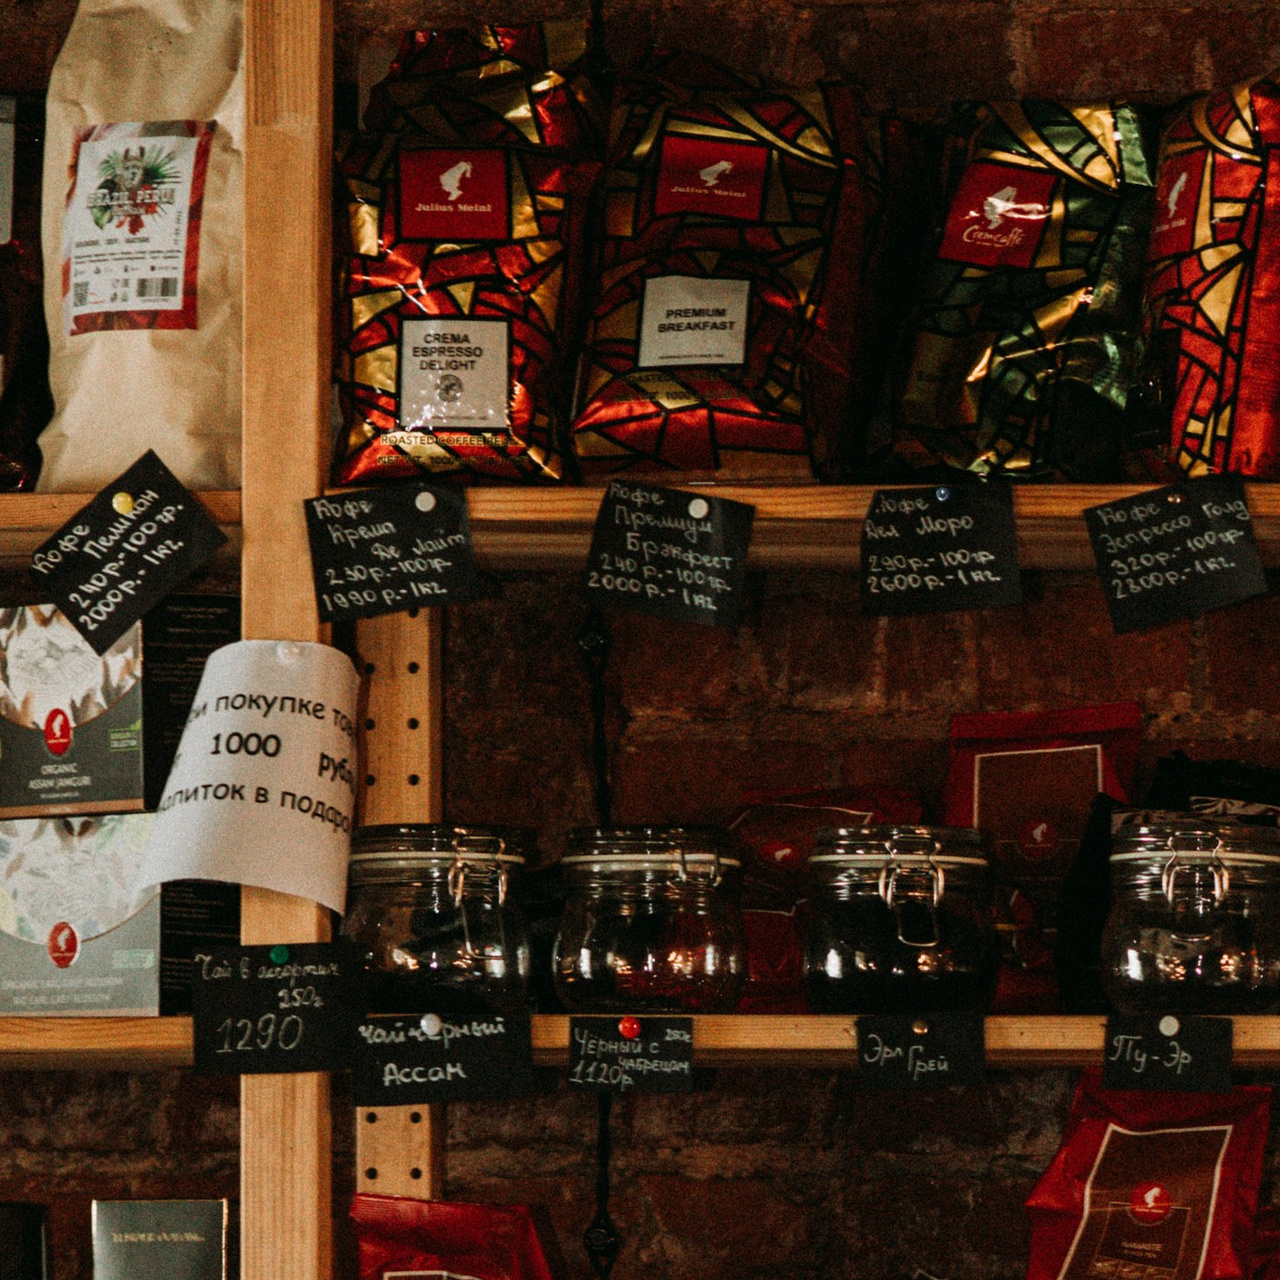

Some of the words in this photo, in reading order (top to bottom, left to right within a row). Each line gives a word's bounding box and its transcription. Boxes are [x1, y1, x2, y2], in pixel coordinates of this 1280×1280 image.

[415, 203, 453, 213] Julius
[458, 203, 492, 213] Meinl
[666, 308, 726, 319] PREMIUM
[658, 321, 736, 333] BREAKFAST
[424, 333, 470, 345] CREMA
[412, 346, 483, 358] ESPRESSO
[420, 359, 477, 371] DELIGHT
[610, 482, 665, 508] Кофе
[312, 499, 373, 520] Кофе
[1096, 502, 1161, 526] Кофе
[32, 524, 90, 574] Кофе
[215, 693, 325, 719] покупке
[211, 732, 282, 757] 1000
[255, 786, 269, 803] в
[216, 1013, 303, 1052] 1290
[649, 1042, 660, 1054] с
[863, 1034, 904, 1066] Эрл
[383, 1062, 467, 1086] Ассам
[907, 1045, 949, 1081] Грей
